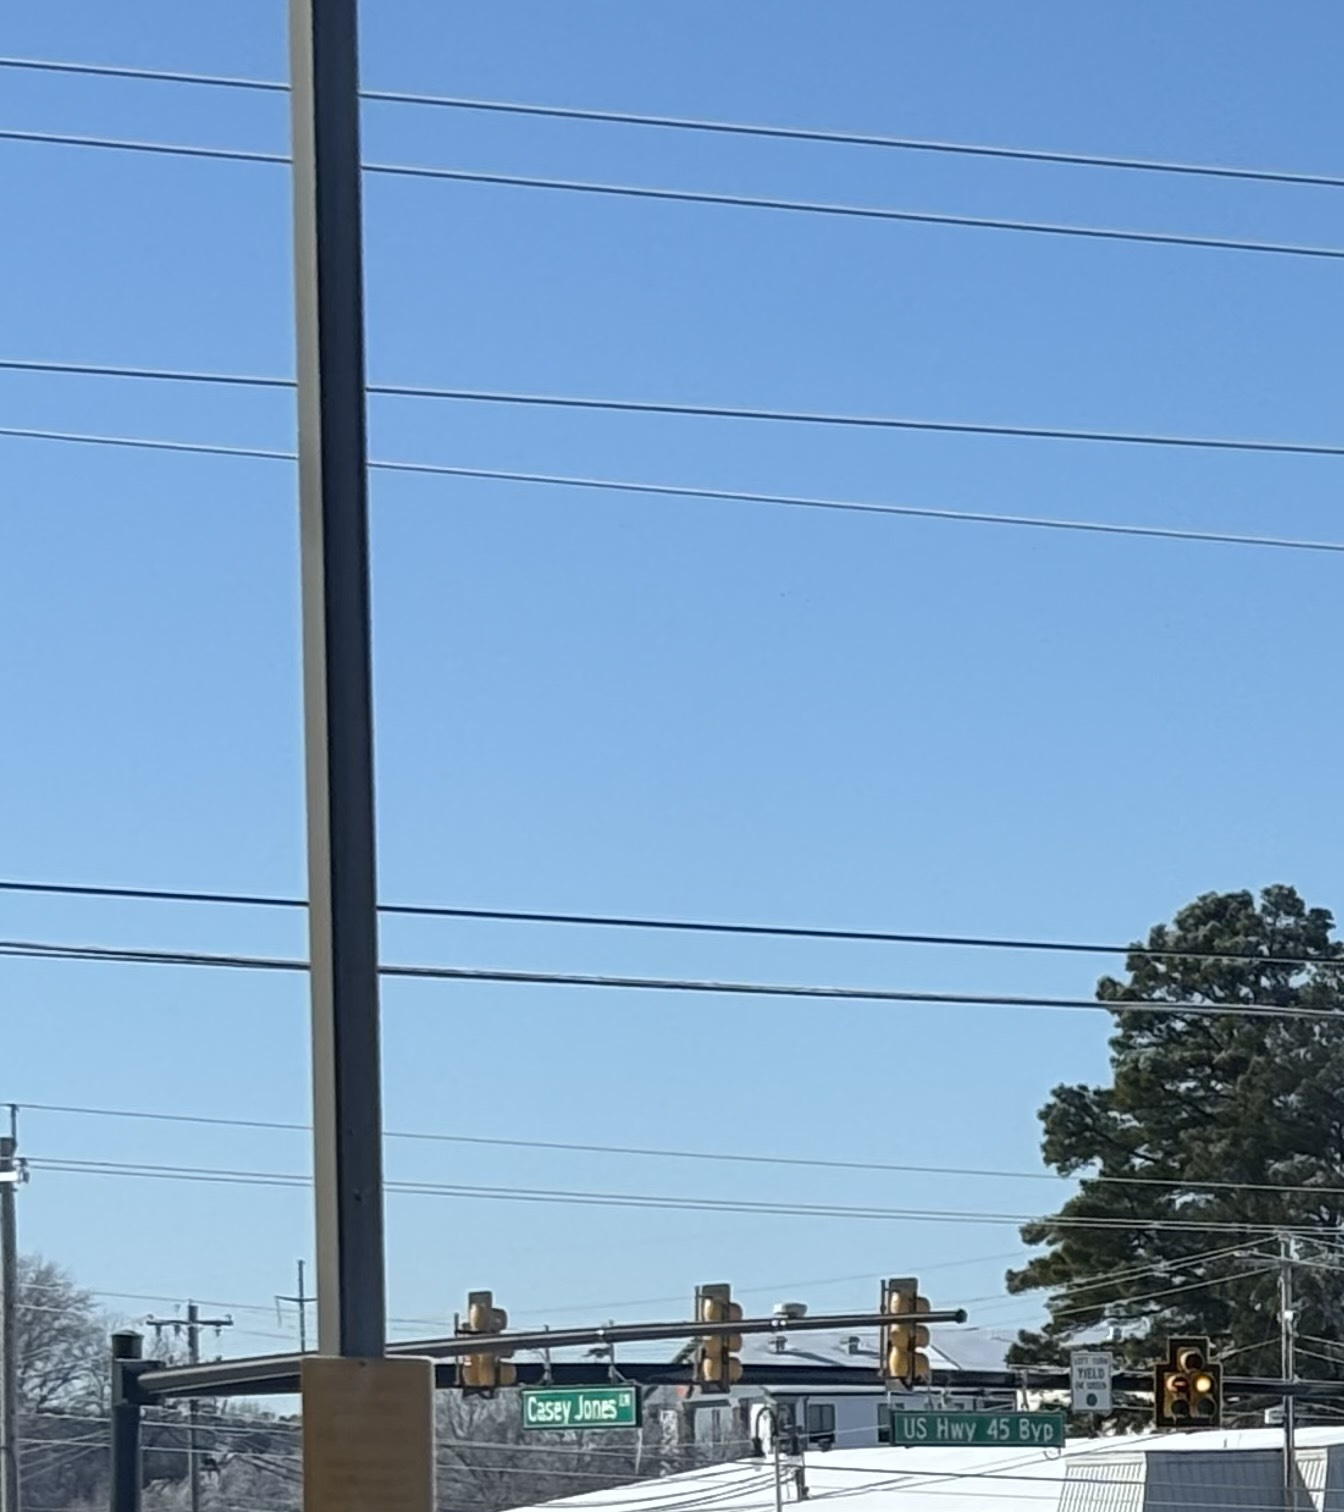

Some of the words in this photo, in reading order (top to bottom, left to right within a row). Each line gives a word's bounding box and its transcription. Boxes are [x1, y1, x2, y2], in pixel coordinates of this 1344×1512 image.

[1077, 1367, 1106, 1380] YIELD
[527, 1396, 572, 1425] Casey
[573, 1394, 618, 1421] Jones
[903, 1417, 928, 1440] US
[936, 1416, 976, 1443] Hwy
[986, 1417, 1010, 1441] 45
[1018, 1417, 1054, 1442] Byp
